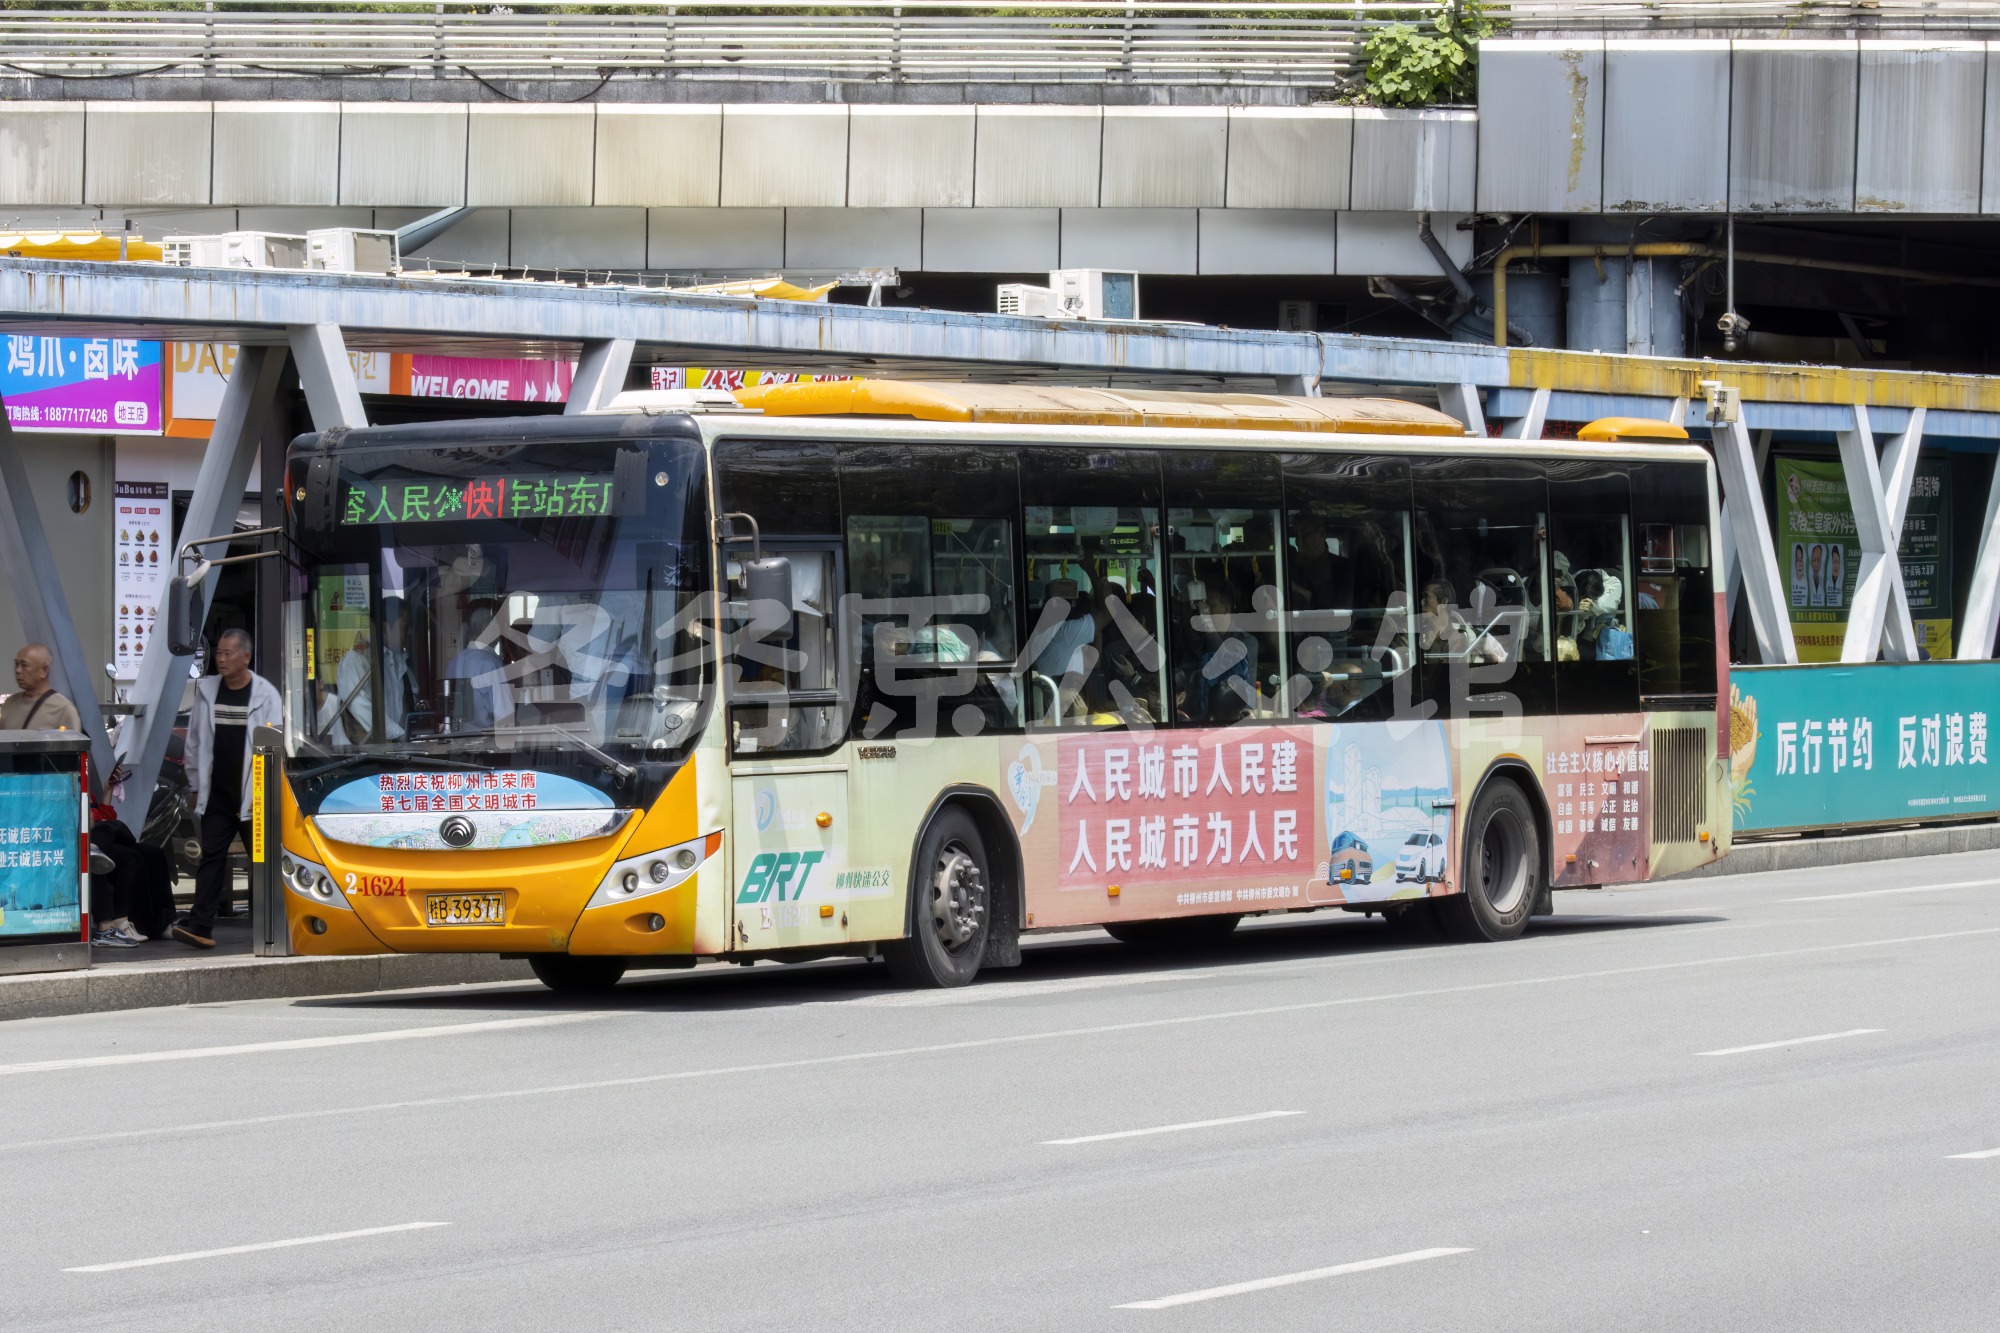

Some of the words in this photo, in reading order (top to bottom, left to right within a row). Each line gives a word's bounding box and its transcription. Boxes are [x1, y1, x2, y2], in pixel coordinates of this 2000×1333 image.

[411, 374, 510, 400] WELCOME
[117, 405, 145, 421] 地王店
[1776, 717, 1873, 776] 厉行节约
[1898, 711, 1987, 769] 反对浪费
[1068, 740, 1298, 804] 人民城市人民建
[1546, 750, 1649, 774] 社会主义核心价值观
[379, 772, 537, 792] 热烈庆祝柳州市荣膺
[1557, 783, 1573, 797] 富强
[1579, 783, 1595, 796] 民主
[1601, 781, 1617, 795] 文明
[1623, 781, 1639, 795] 和谐
[380, 793, 537, 812] 第七届全国文明城市
[1557, 802, 1573, 816] 自由
[1579, 801, 1595, 815] 平等
[1601, 800, 1617, 814] 公正
[1623, 799, 1639, 813] 法治
[1557, 820, 1573, 834] 爱国
[1579, 818, 1595, 833] 敬业
[1601, 818, 1617, 832] 诚信
[1622, 817, 1639, 831] 友善
[1068, 809, 1299, 875] 人民城市为人民
[345, 873, 407, 897] 2-1624
[736, 851, 825, 904] BRT
[836, 869, 889, 890] 柳州快速公交
